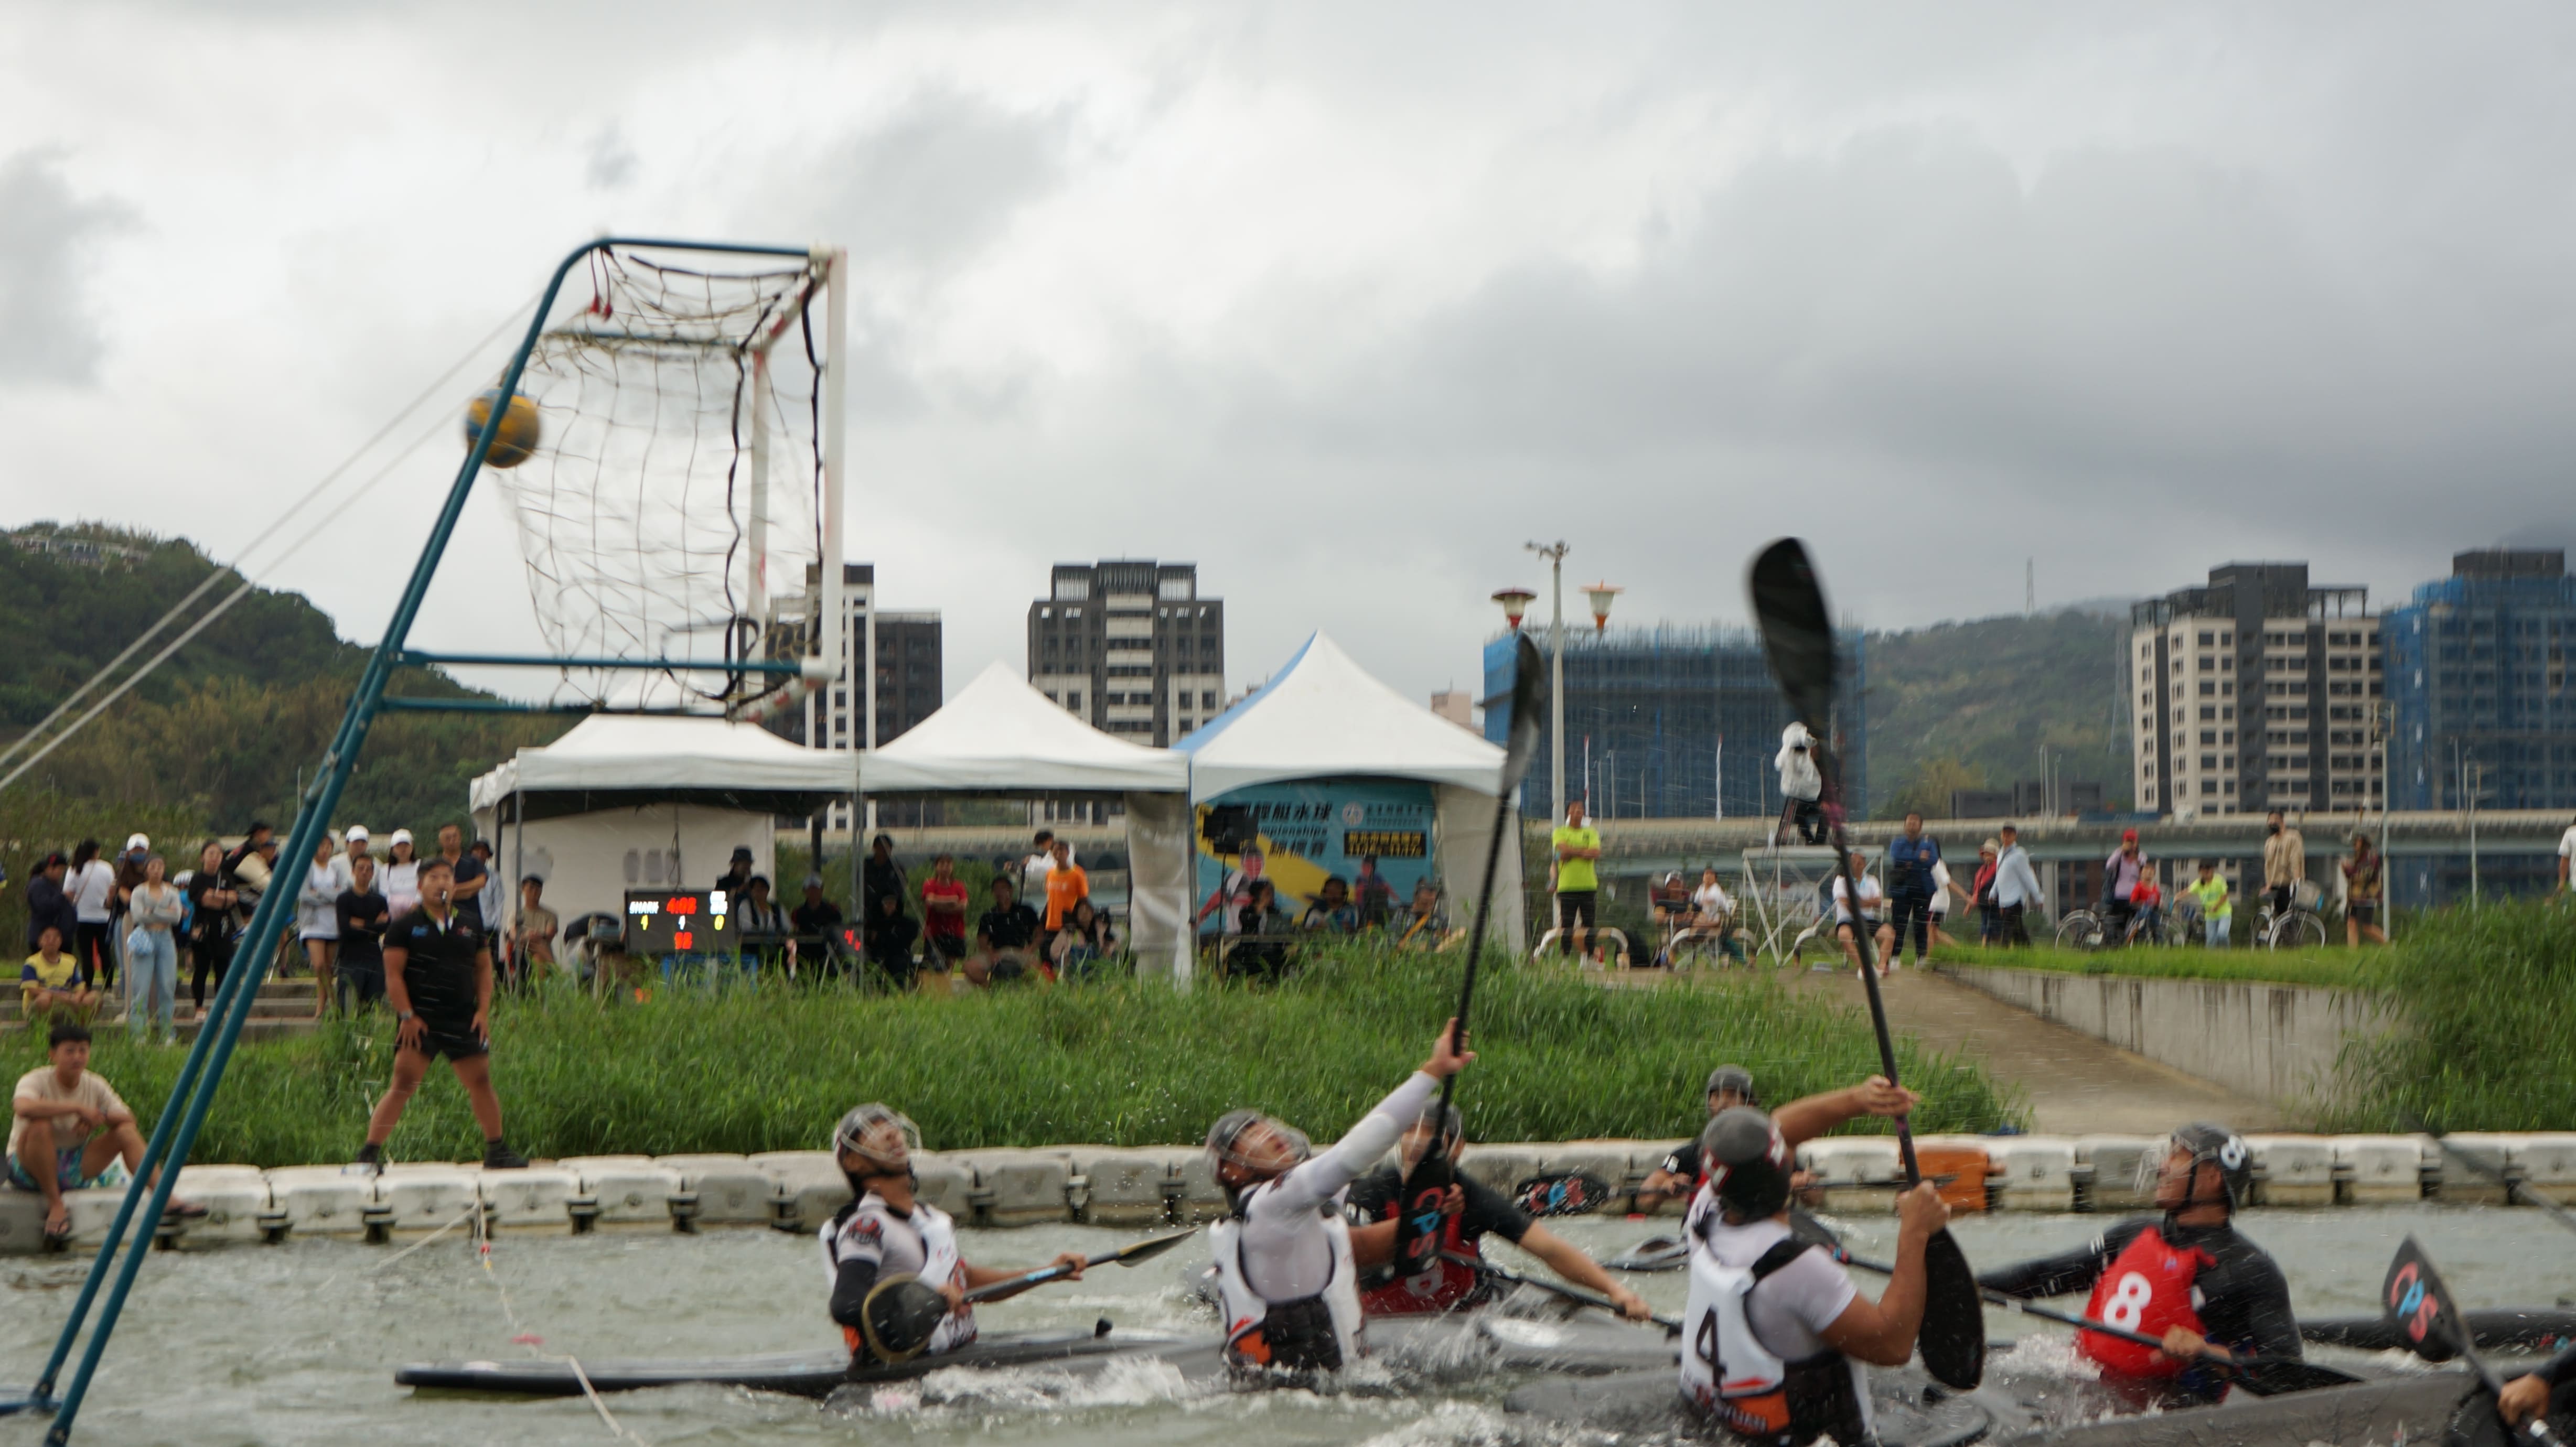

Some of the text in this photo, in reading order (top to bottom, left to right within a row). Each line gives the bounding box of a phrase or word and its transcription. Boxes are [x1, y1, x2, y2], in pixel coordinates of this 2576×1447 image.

[629, 901, 659, 914] SHARK
[641, 914, 724, 931] 1 1 0
[1408, 1186, 1445, 1258] CPS
[2103, 1271, 2152, 1335] 8
[2389, 1260, 2439, 1343] CPS
[1696, 1304, 1724, 1389] 4
